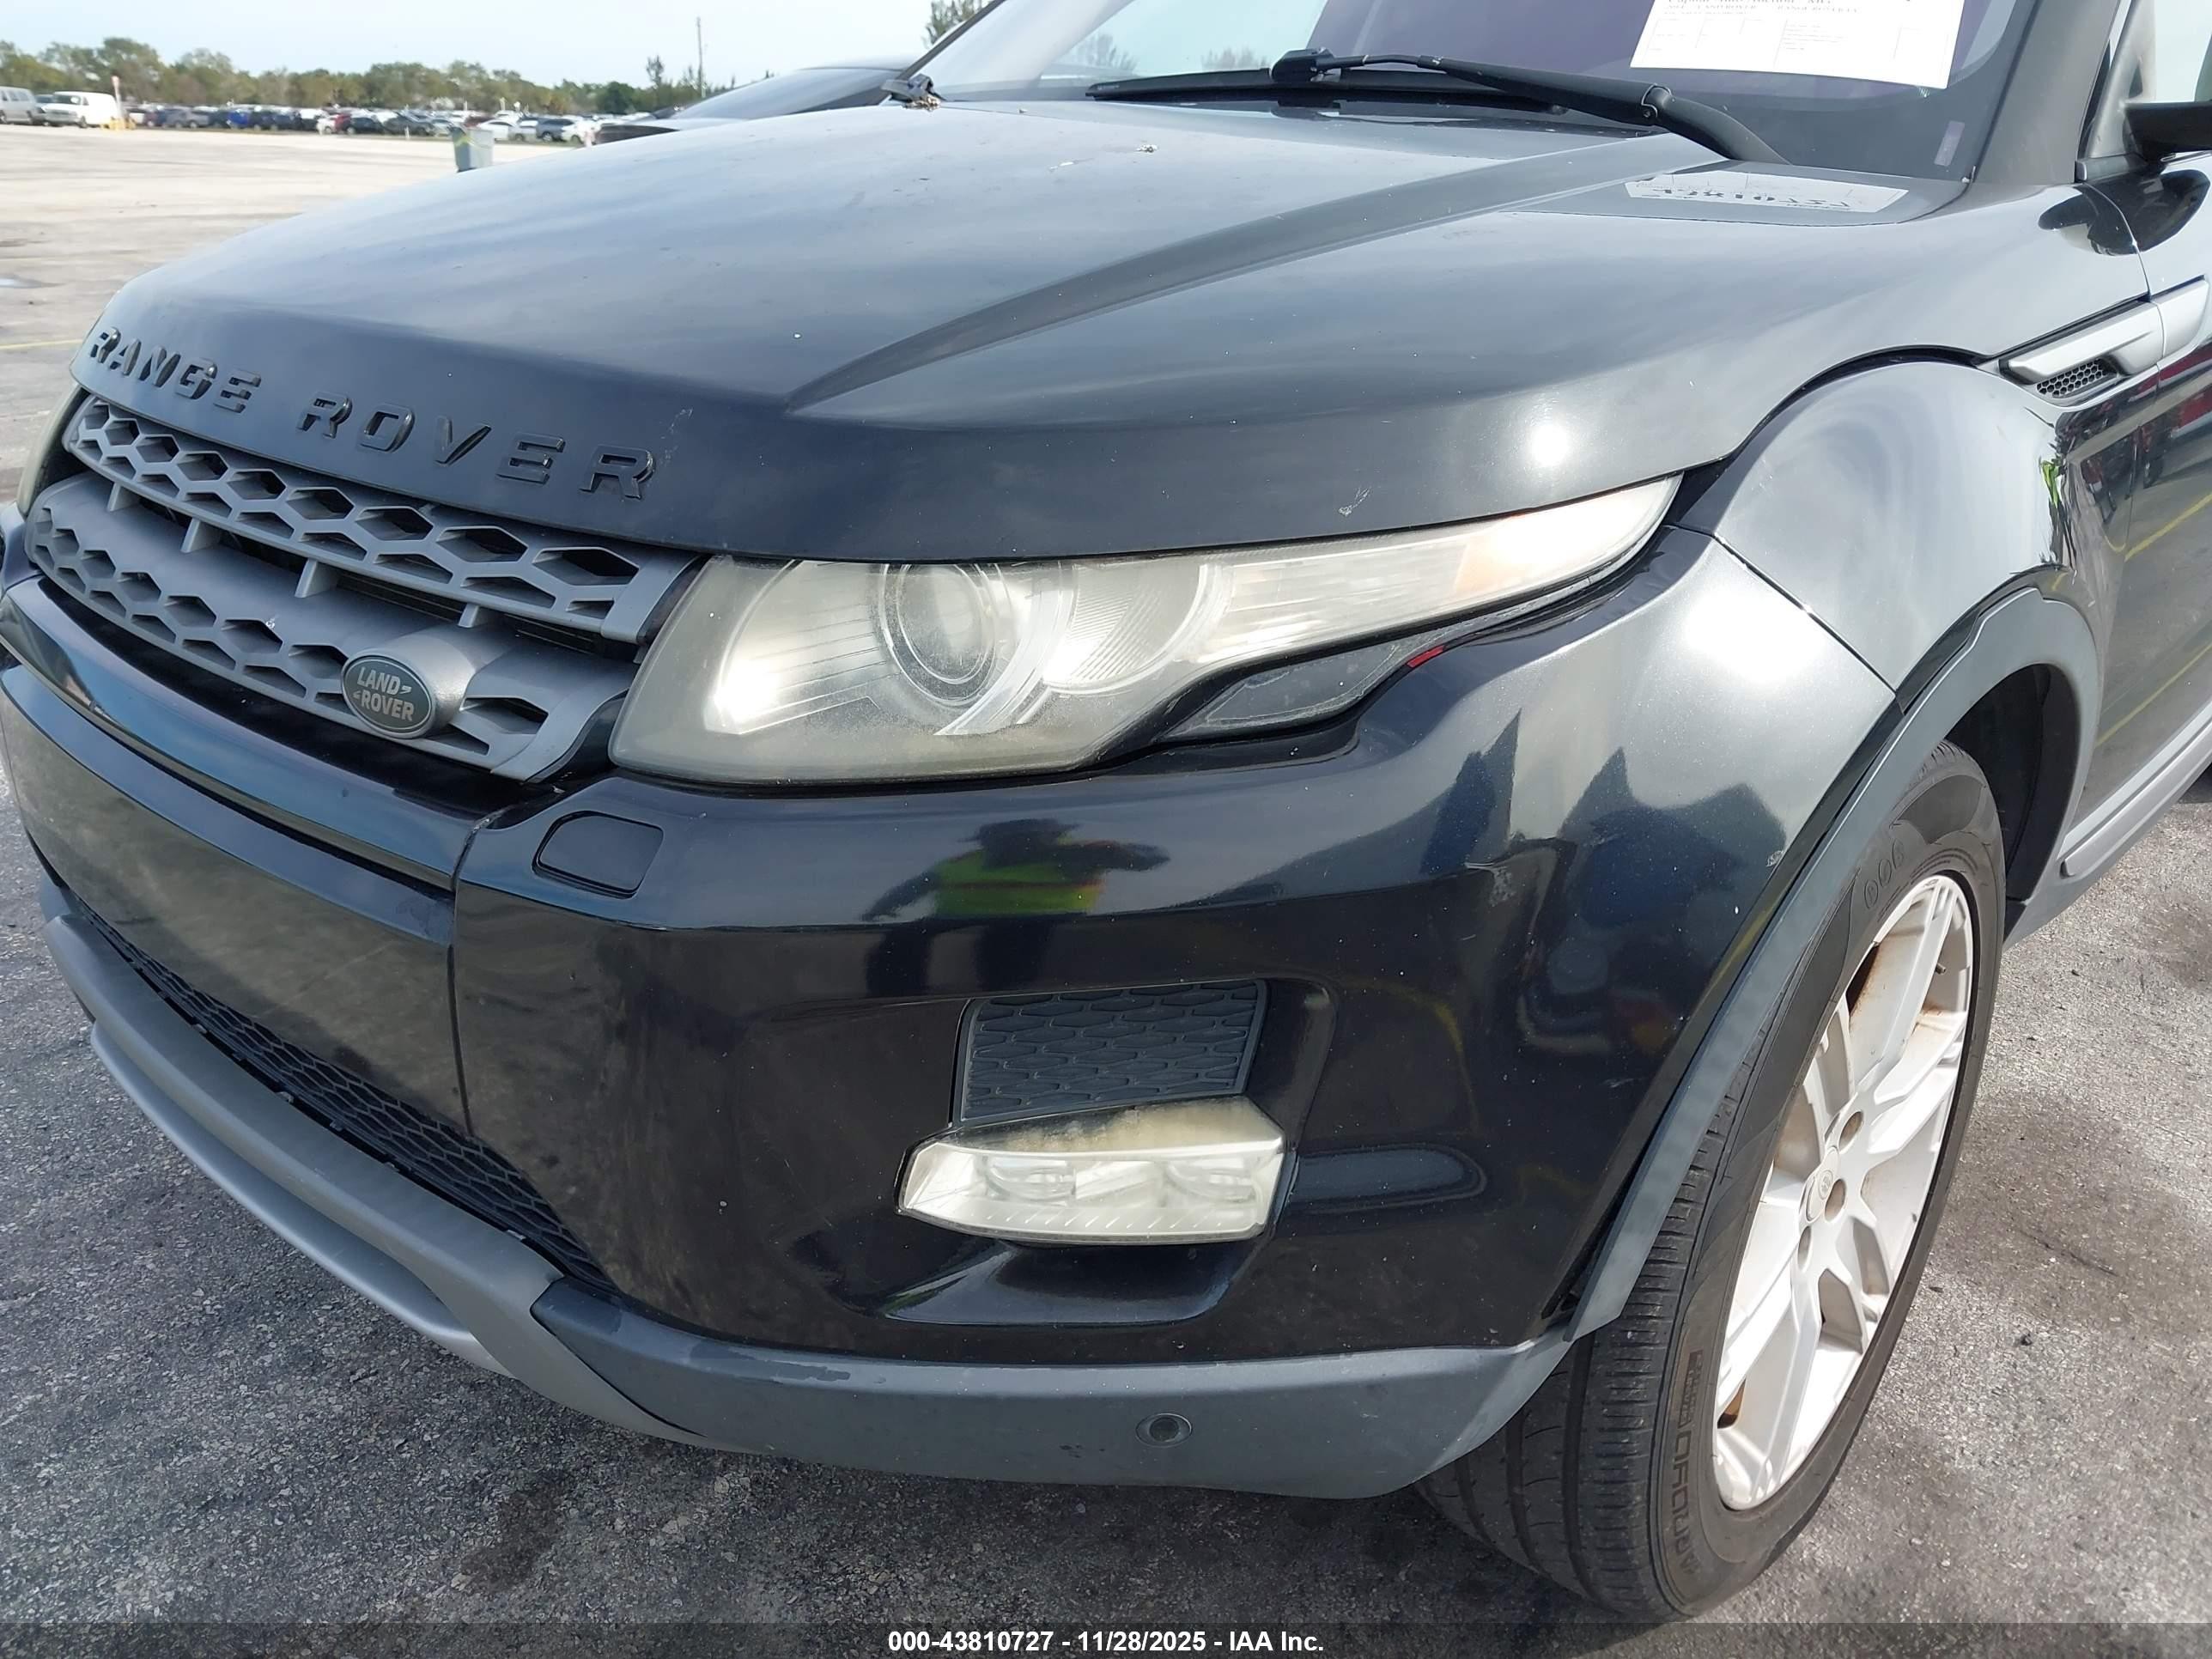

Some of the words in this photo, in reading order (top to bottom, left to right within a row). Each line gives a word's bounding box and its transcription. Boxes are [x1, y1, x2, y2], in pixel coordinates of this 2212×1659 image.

[89, 326, 261, 414] RANGE
[295, 391, 656, 501] ROVER
[356, 666, 401, 696] LAND
[360, 690, 415, 721] ROVER
